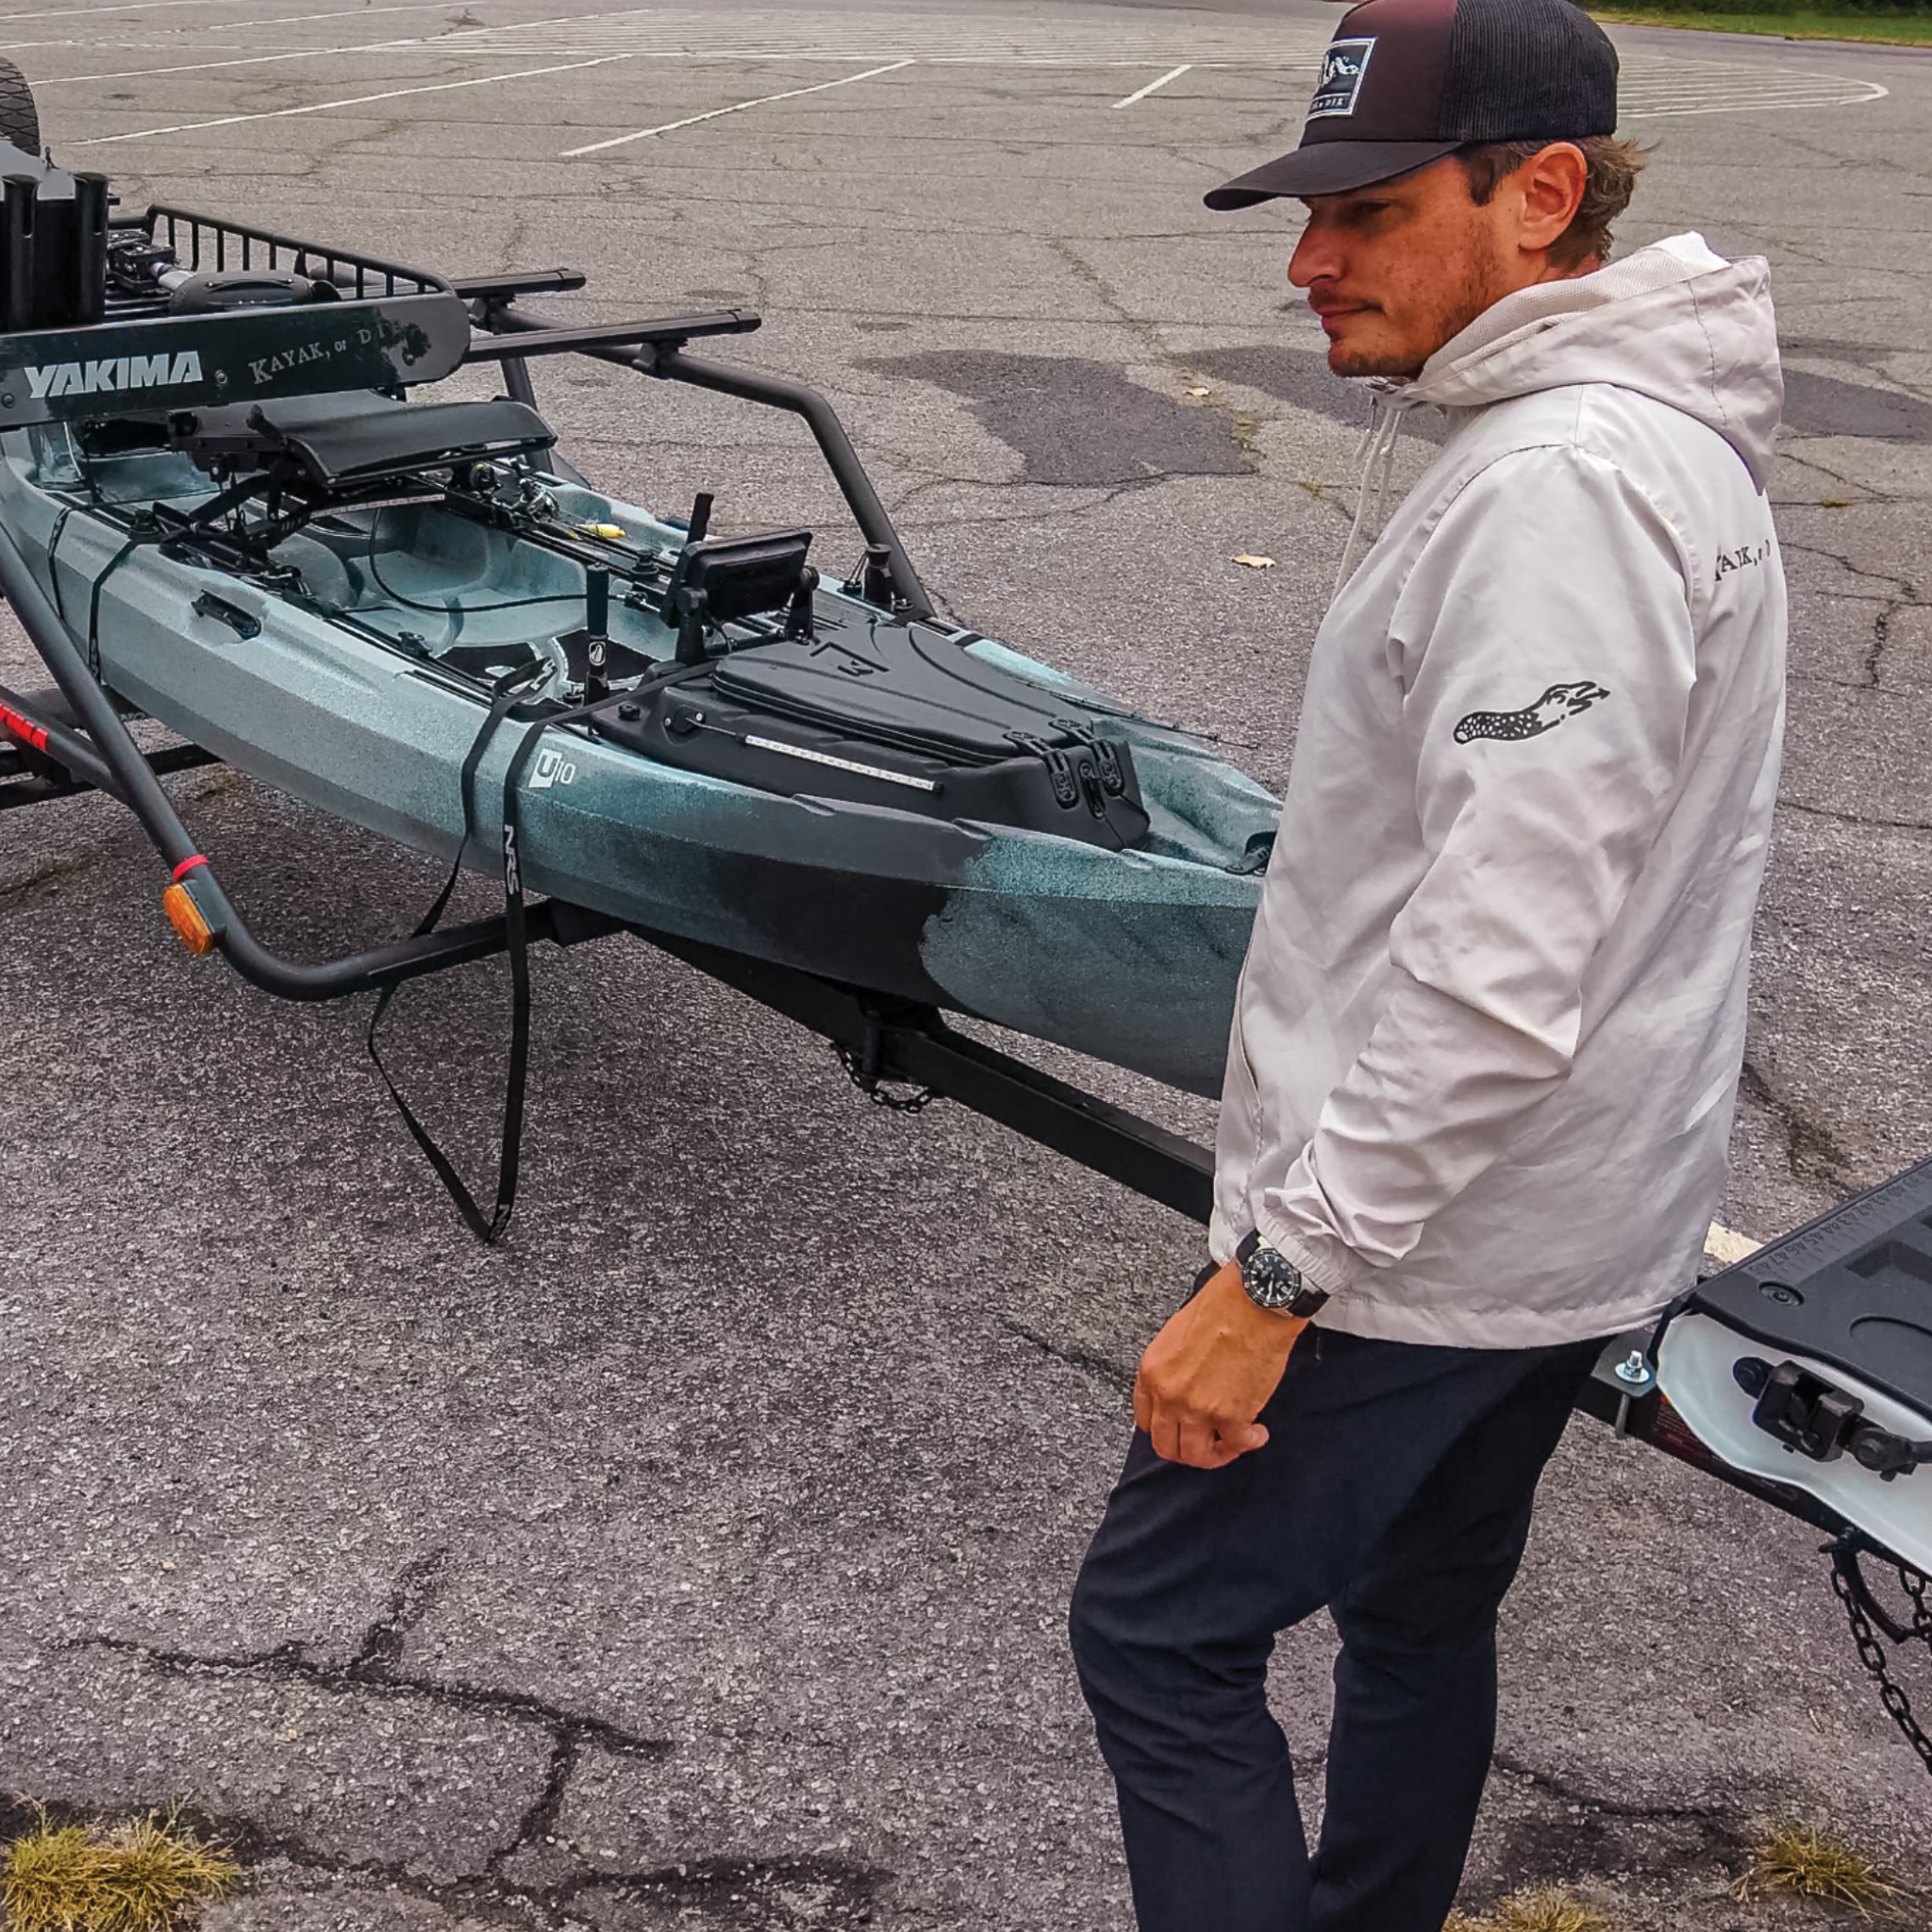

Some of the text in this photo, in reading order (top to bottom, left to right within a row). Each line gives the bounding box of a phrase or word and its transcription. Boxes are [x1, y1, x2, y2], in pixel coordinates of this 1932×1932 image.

[24, 350, 203, 399] YAKIMA
[248, 341, 330, 384] KAYAK,
[504, 824, 520, 895] NRS
